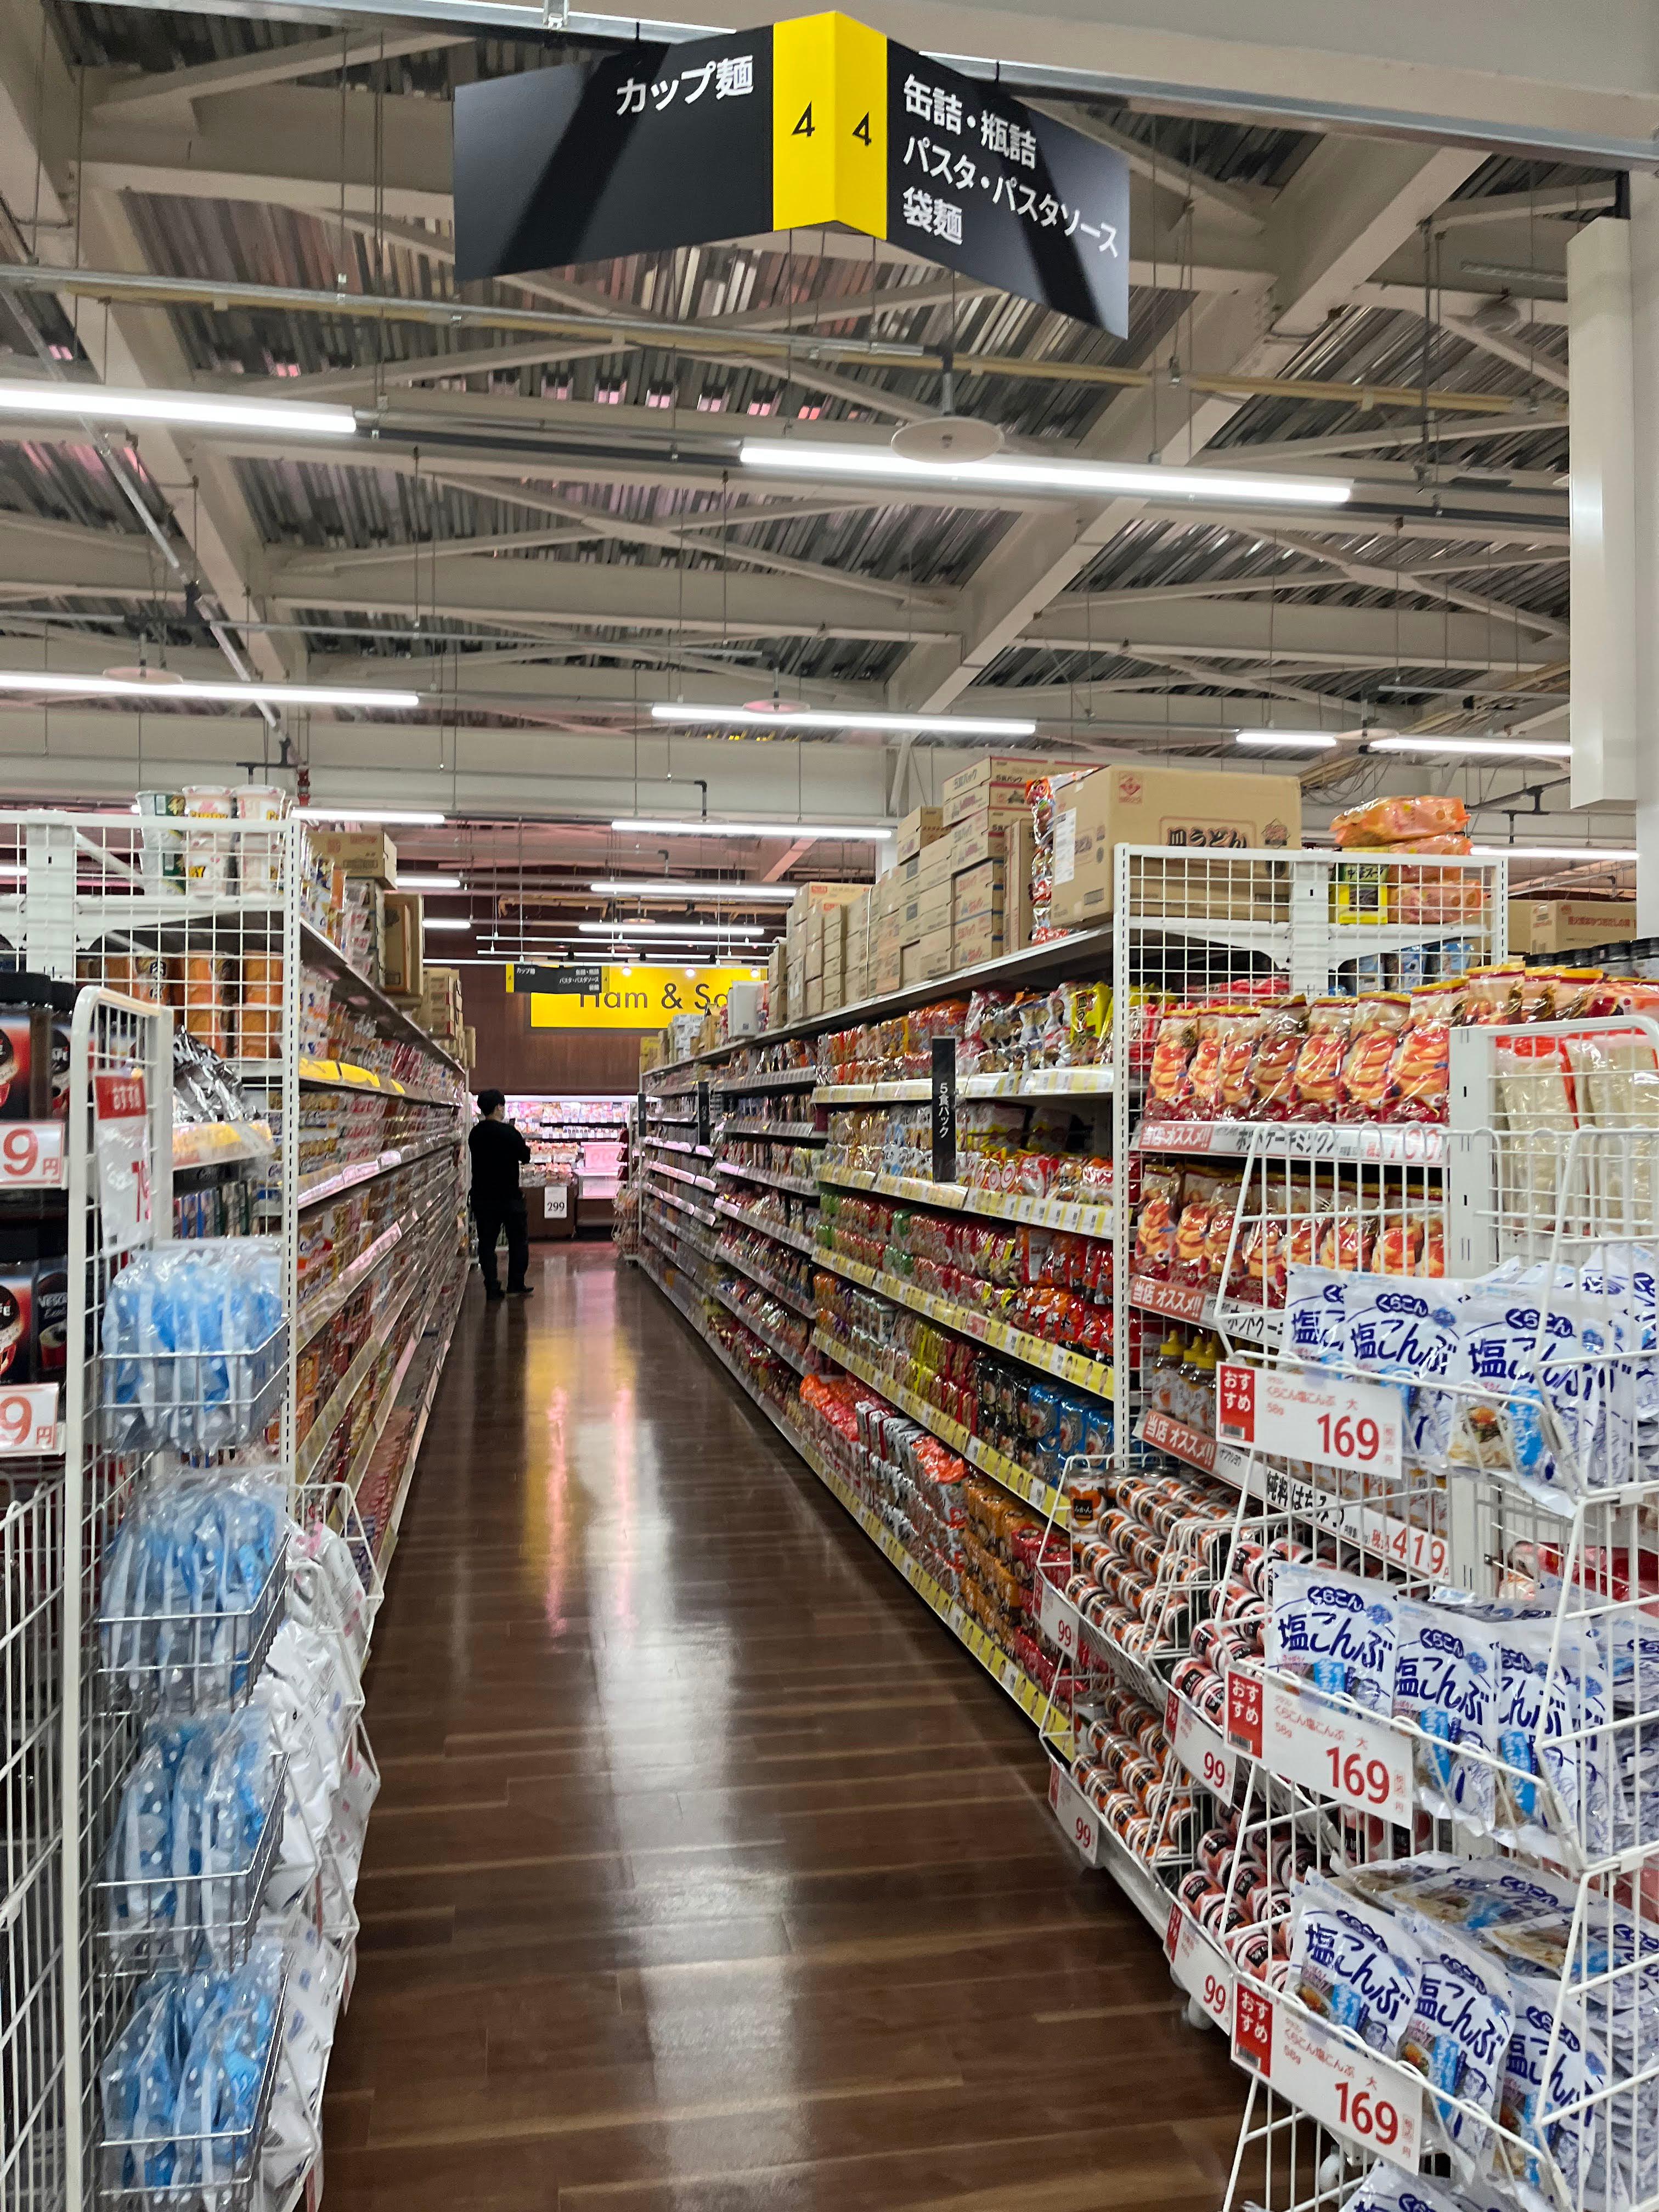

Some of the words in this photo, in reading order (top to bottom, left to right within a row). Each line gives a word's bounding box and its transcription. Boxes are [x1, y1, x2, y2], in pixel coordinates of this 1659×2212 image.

[616, 54, 755, 115] カップ麺
[792, 102, 814, 138] 4
[852, 111, 872, 146] 4
[904, 74, 1037, 170] 缶詰・瓶詰
[903, 136, 1119, 257] パスタ・パスタソース
[903, 186, 963, 246] 袋麺
[661, 983, 683, 1009] &
[547, 1201, 565, 1212] 299
[1376, 1293, 1428, 1318] くらこん
[1505, 1308, 1573, 1338] くらこん
[1350, 1319, 1458, 1375] 塩こんぶ
[1223, 1370, 1251, 1391] おす
[1223, 1391, 1251, 1412] すめ
[1346, 1399, 1358, 1411] 大
[1317, 1413, 1380, 1462] 169
[1393, 1527, 1446, 1575] 419
[1308, 1587, 1364, 1613] くらこん
[1058, 1619, 1071, 1648] 99
[1278, 1613, 1392, 1672] 塩こんぶ
[1233, 1677, 1260, 1703] おす
[1233, 1701, 1260, 1726] すめ
[1356, 1737, 1368, 1751] 大
[1203, 1751, 1225, 1788] 99
[1326, 1746, 1390, 1804] 169
[1076, 1816, 1091, 1848] 99
[1305, 1922, 1411, 2021] 塩こんぶ
[1203, 1974, 1226, 2015] 99
[1242, 1992, 1268, 2019] おす
[1240, 2013, 1268, 2044] すめ
[1365, 2075, 1378, 2091] 大
[1334, 2081, 1398, 2146] 169
